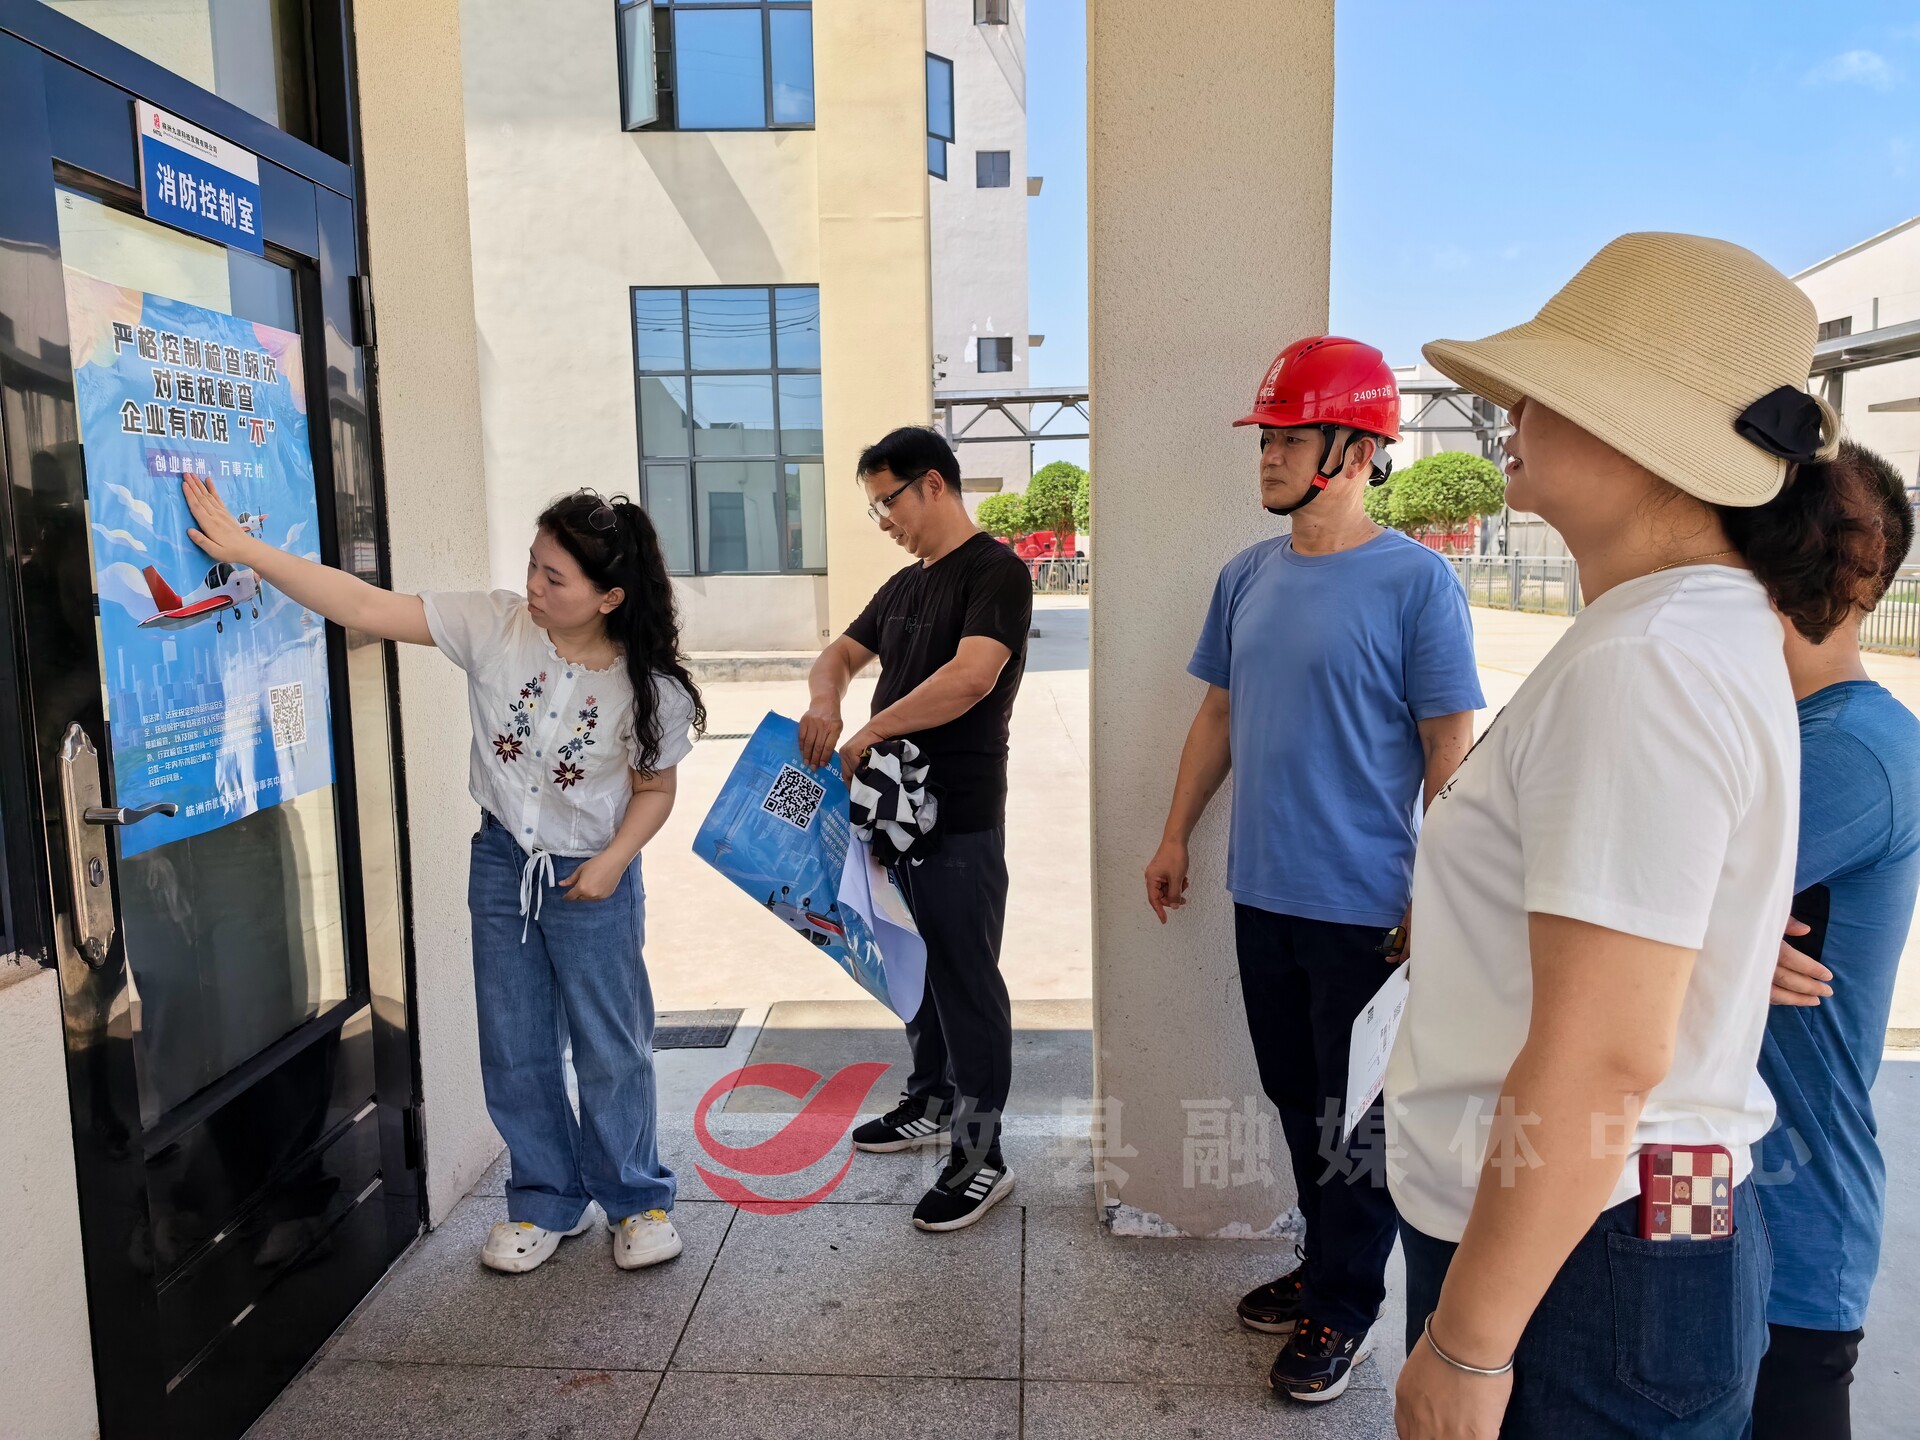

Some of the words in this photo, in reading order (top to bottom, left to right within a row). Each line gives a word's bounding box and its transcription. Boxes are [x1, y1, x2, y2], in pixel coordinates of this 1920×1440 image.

[156, 161, 256, 236] 消防控制室
[112, 321, 278, 385] 严格控制检查频次
[152, 369, 255, 413] 对违规检查
